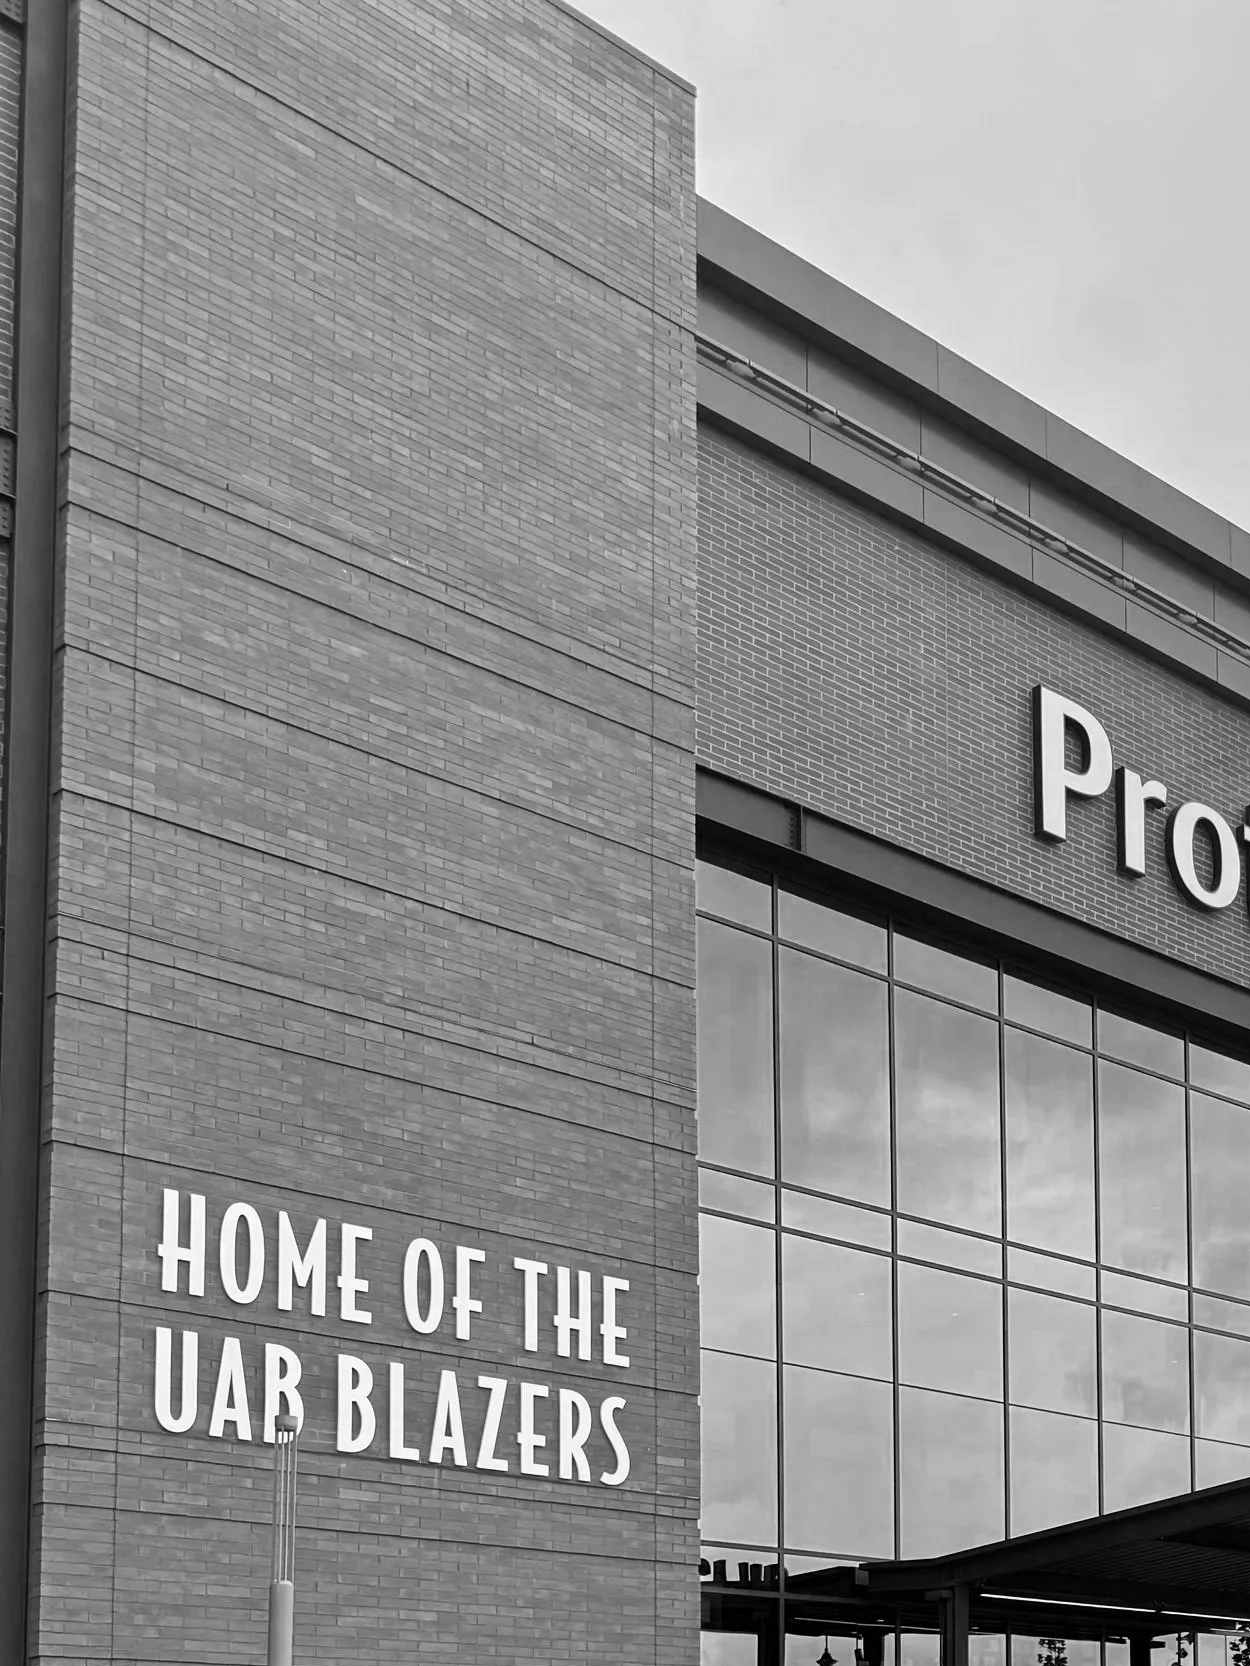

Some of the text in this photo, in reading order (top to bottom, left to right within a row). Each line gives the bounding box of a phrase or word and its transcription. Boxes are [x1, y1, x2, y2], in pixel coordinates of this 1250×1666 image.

[158, 1188, 630, 1367] HOME OF THE
[154, 1326, 630, 1486] UAB BLAZERS
